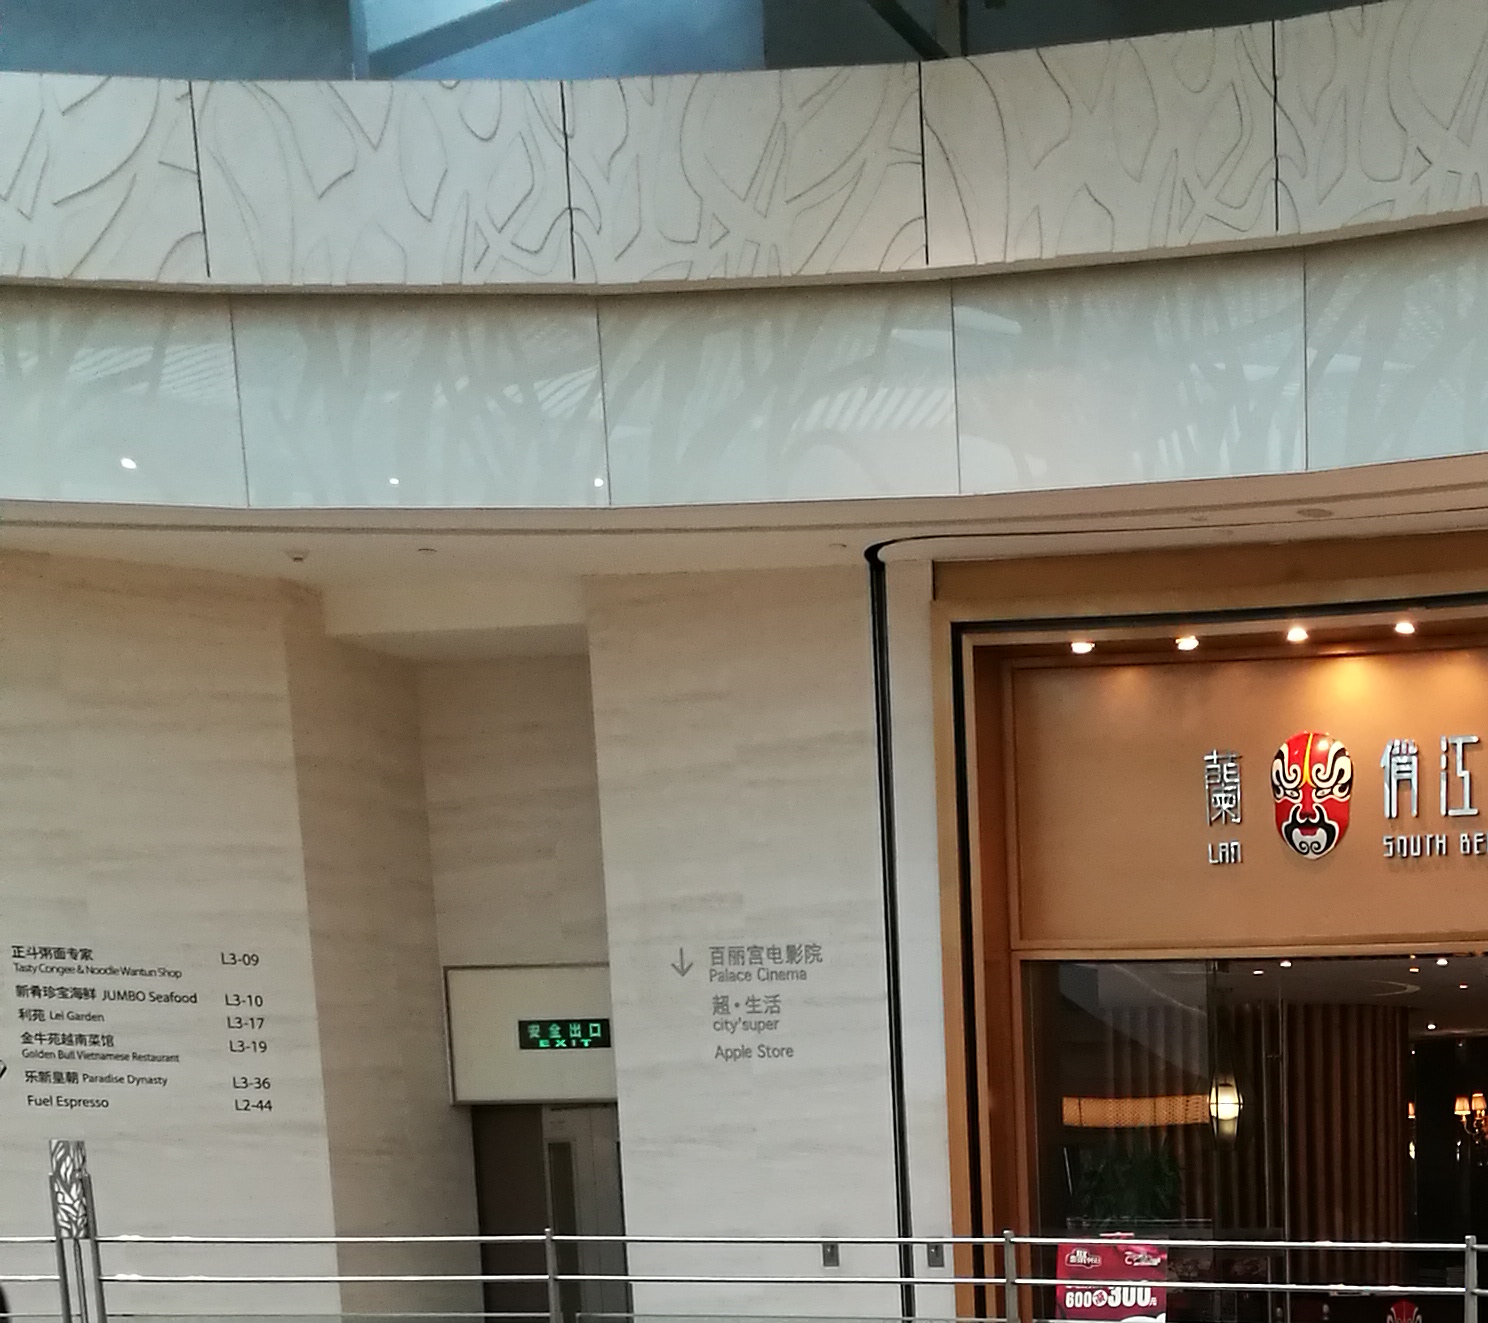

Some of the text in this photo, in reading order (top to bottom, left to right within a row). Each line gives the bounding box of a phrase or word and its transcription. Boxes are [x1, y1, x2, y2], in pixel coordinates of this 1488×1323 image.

[1383, 833, 1448, 858] SOUTH
[1207, 842, 1242, 865] LAN
[221, 952, 259, 966] L3-09
[709, 943, 823, 966] 百丽宫电影院
[13, 962, 37, 974] Tasty
[39, 963, 75, 977] Congee
[77, 965, 85, 975] &
[86, 965, 119, 976] Noodle
[158, 968, 182, 979] Shop
[709, 967, 807, 982] Palace Cinema
[102, 990, 146, 1002] JUMBO
[149, 991, 198, 1004] Seafood
[225, 994, 264, 1007] L3-10
[67, 1011, 105, 1022] Garden
[227, 1016, 265, 1029] L3-17
[527, 1022, 602, 1039] 安全出口
[713, 1017, 780, 1034] city'super
[20, 1031, 115, 1047] 金牛苑越南菜馆
[538, 1038, 593, 1048] EXIT
[229, 1040, 268, 1053] L3-19
[715, 1044, 794, 1061] Apple Store
[22, 1049, 180, 1063] Golden Bull Vietnamese Restaurant
[83, 1073, 125, 1083] Paradise
[127, 1074, 168, 1087] Dynasty
[233, 1076, 271, 1089] L3-36
[27, 1095, 109, 1109] Fuel Espresso
[235, 1099, 273, 1111] L2-44
